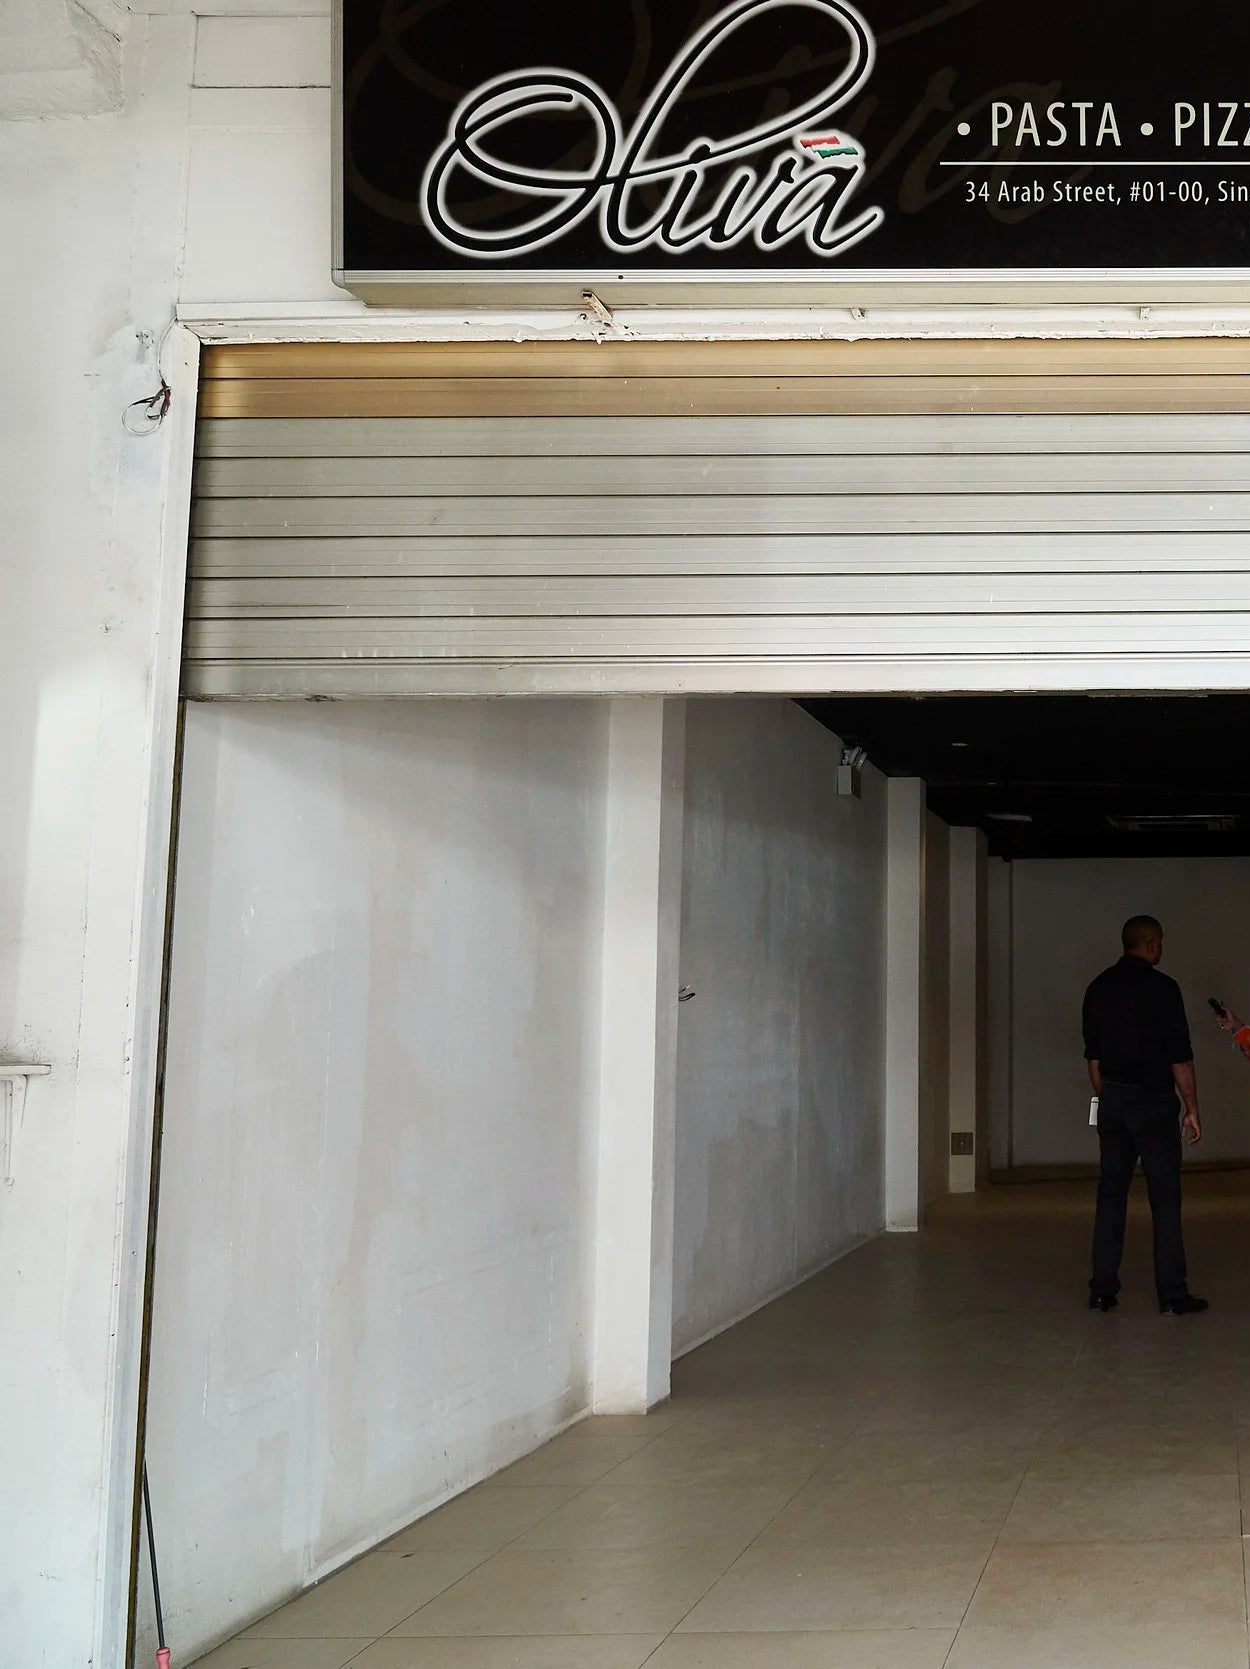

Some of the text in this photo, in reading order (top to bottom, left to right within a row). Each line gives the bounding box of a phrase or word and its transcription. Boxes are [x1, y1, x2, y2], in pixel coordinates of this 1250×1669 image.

[991, 102, 1122, 147] PASTA
[965, 181, 990, 203] 34
[997, 180, 1045, 203] Arab
[1053, 180, 1121, 206] Street,
[1129, 181, 1210, 206] #01-00,
